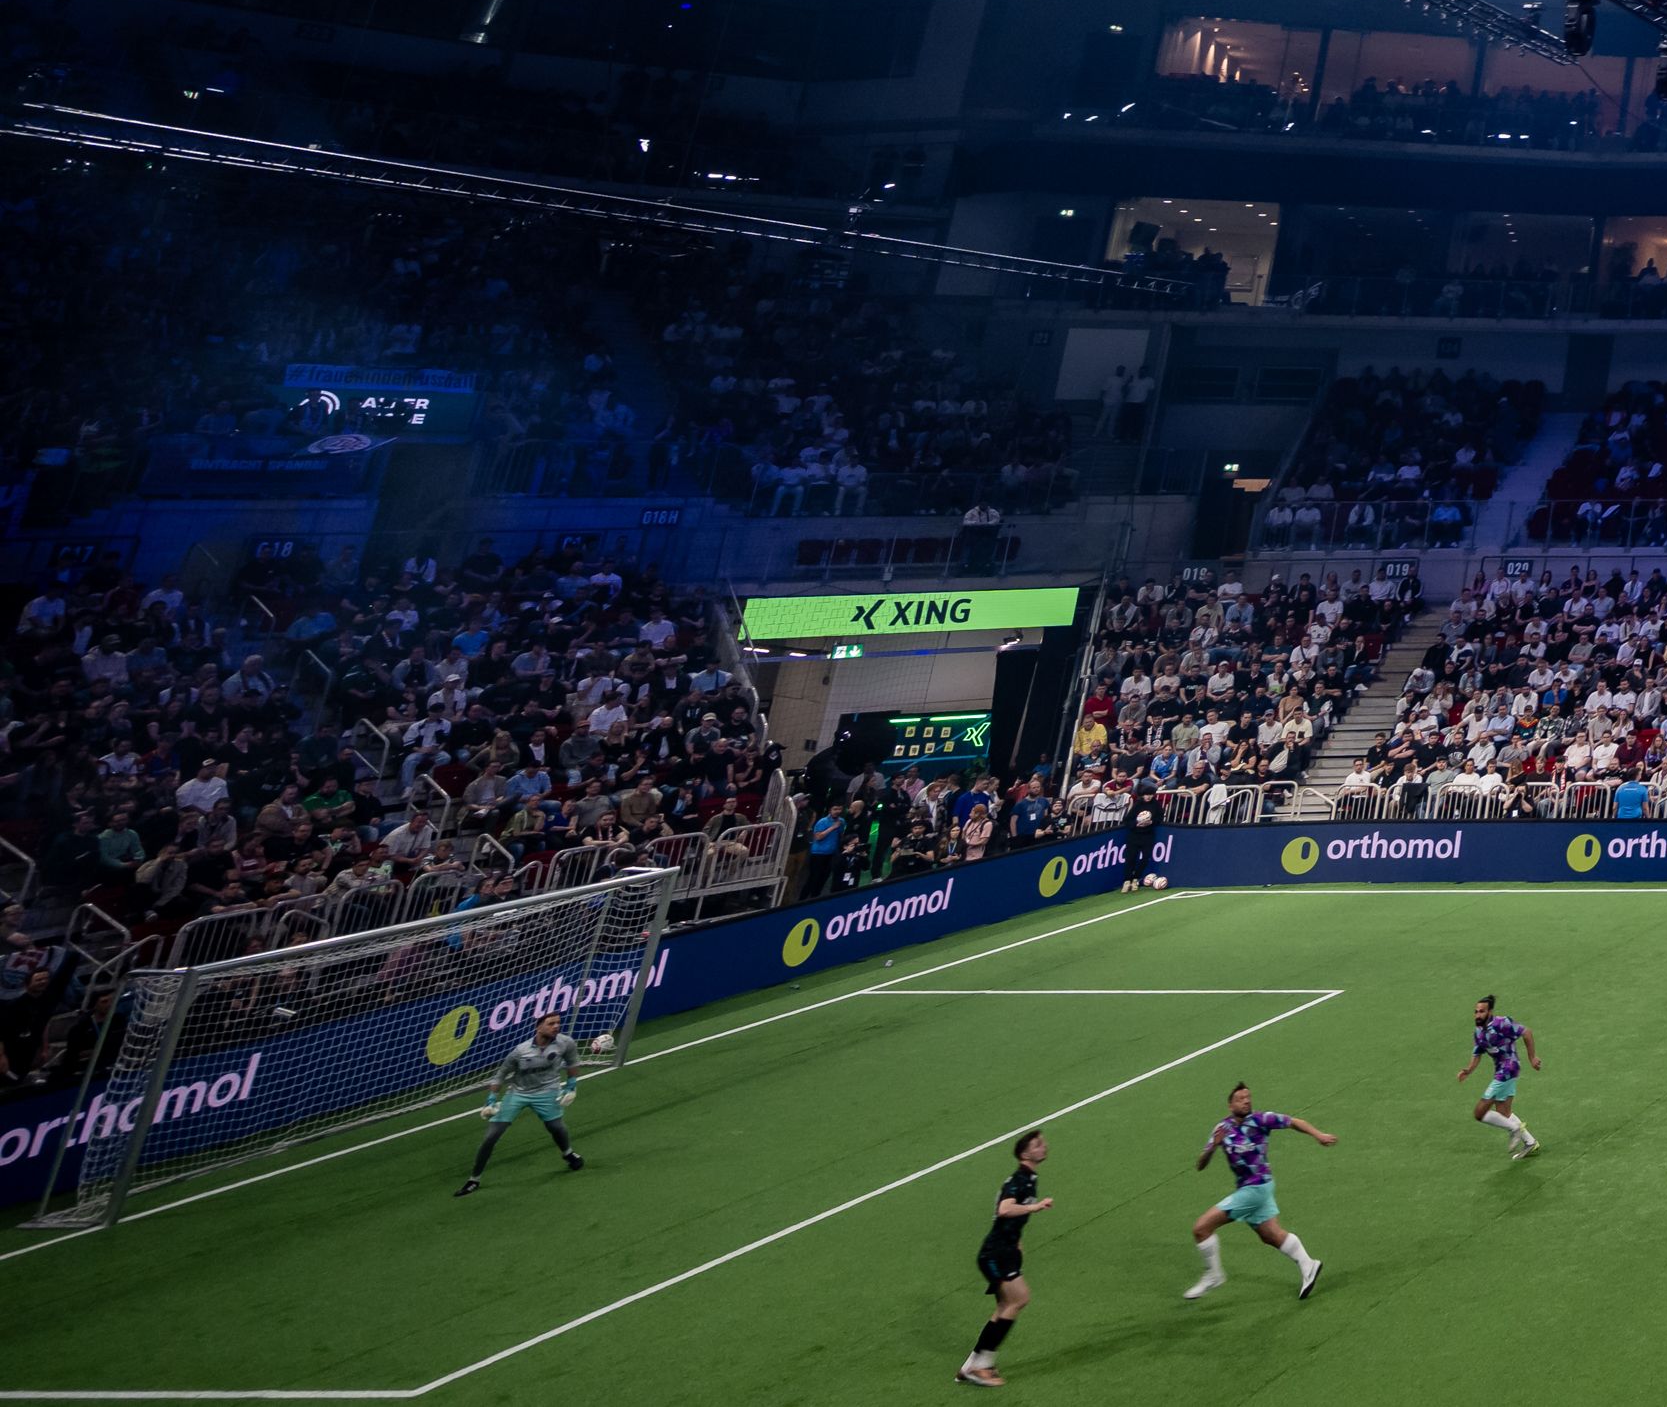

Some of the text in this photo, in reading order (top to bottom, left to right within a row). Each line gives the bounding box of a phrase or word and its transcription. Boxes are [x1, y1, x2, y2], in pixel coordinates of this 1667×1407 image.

[1385, 563, 1409, 576] 019
[889, 598, 972, 625] XING
[1326, 830, 1462, 860] orthomol
[825, 877, 954, 941] orthomol
[489, 949, 670, 1032] orthomol
